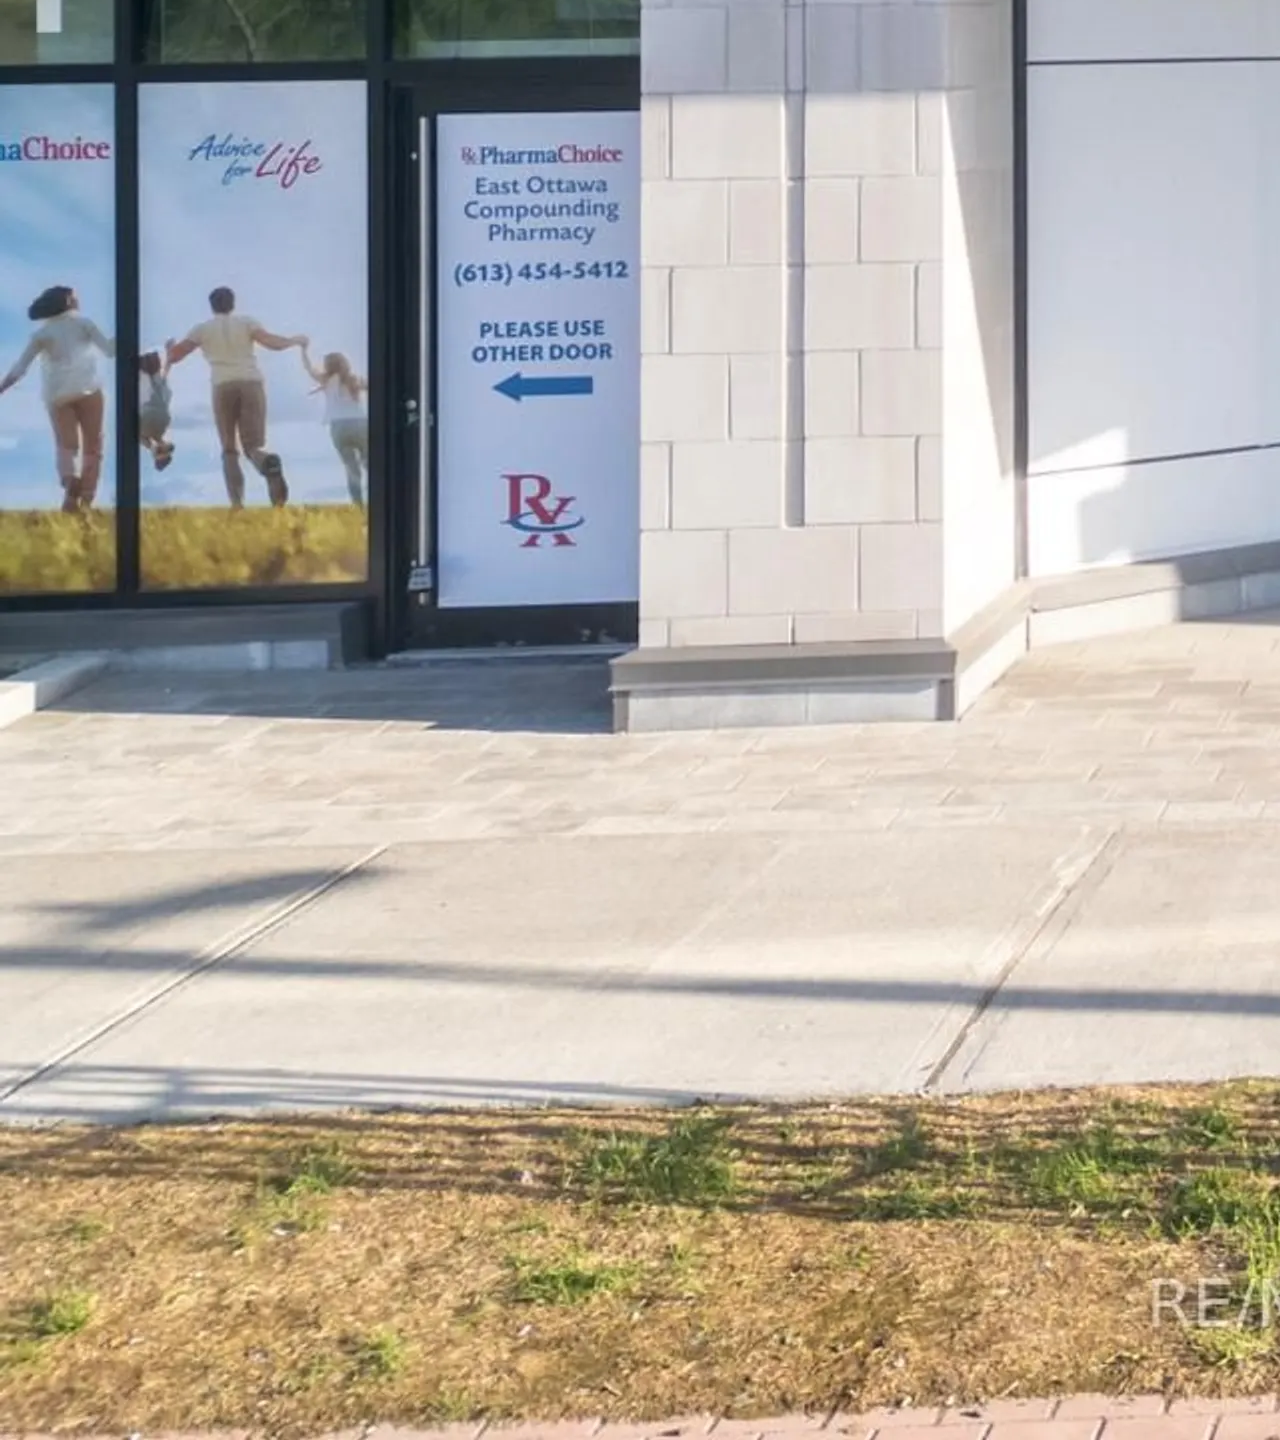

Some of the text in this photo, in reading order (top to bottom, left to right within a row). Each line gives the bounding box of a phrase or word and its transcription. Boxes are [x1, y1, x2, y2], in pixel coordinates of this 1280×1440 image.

[188, 133, 265, 160] Advice
[480, 144, 623, 165] PharmaChoice
[221, 140, 322, 189] for Life
[475, 176, 608, 195] East Ottawa
[464, 199, 619, 222] Compounding
[488, 223, 596, 245] Pharmacy
[454, 261, 629, 287] (613) 454-5412
[480, 320, 605, 338] PLEASE USE
[472, 343, 613, 362] OTHER DOOR
